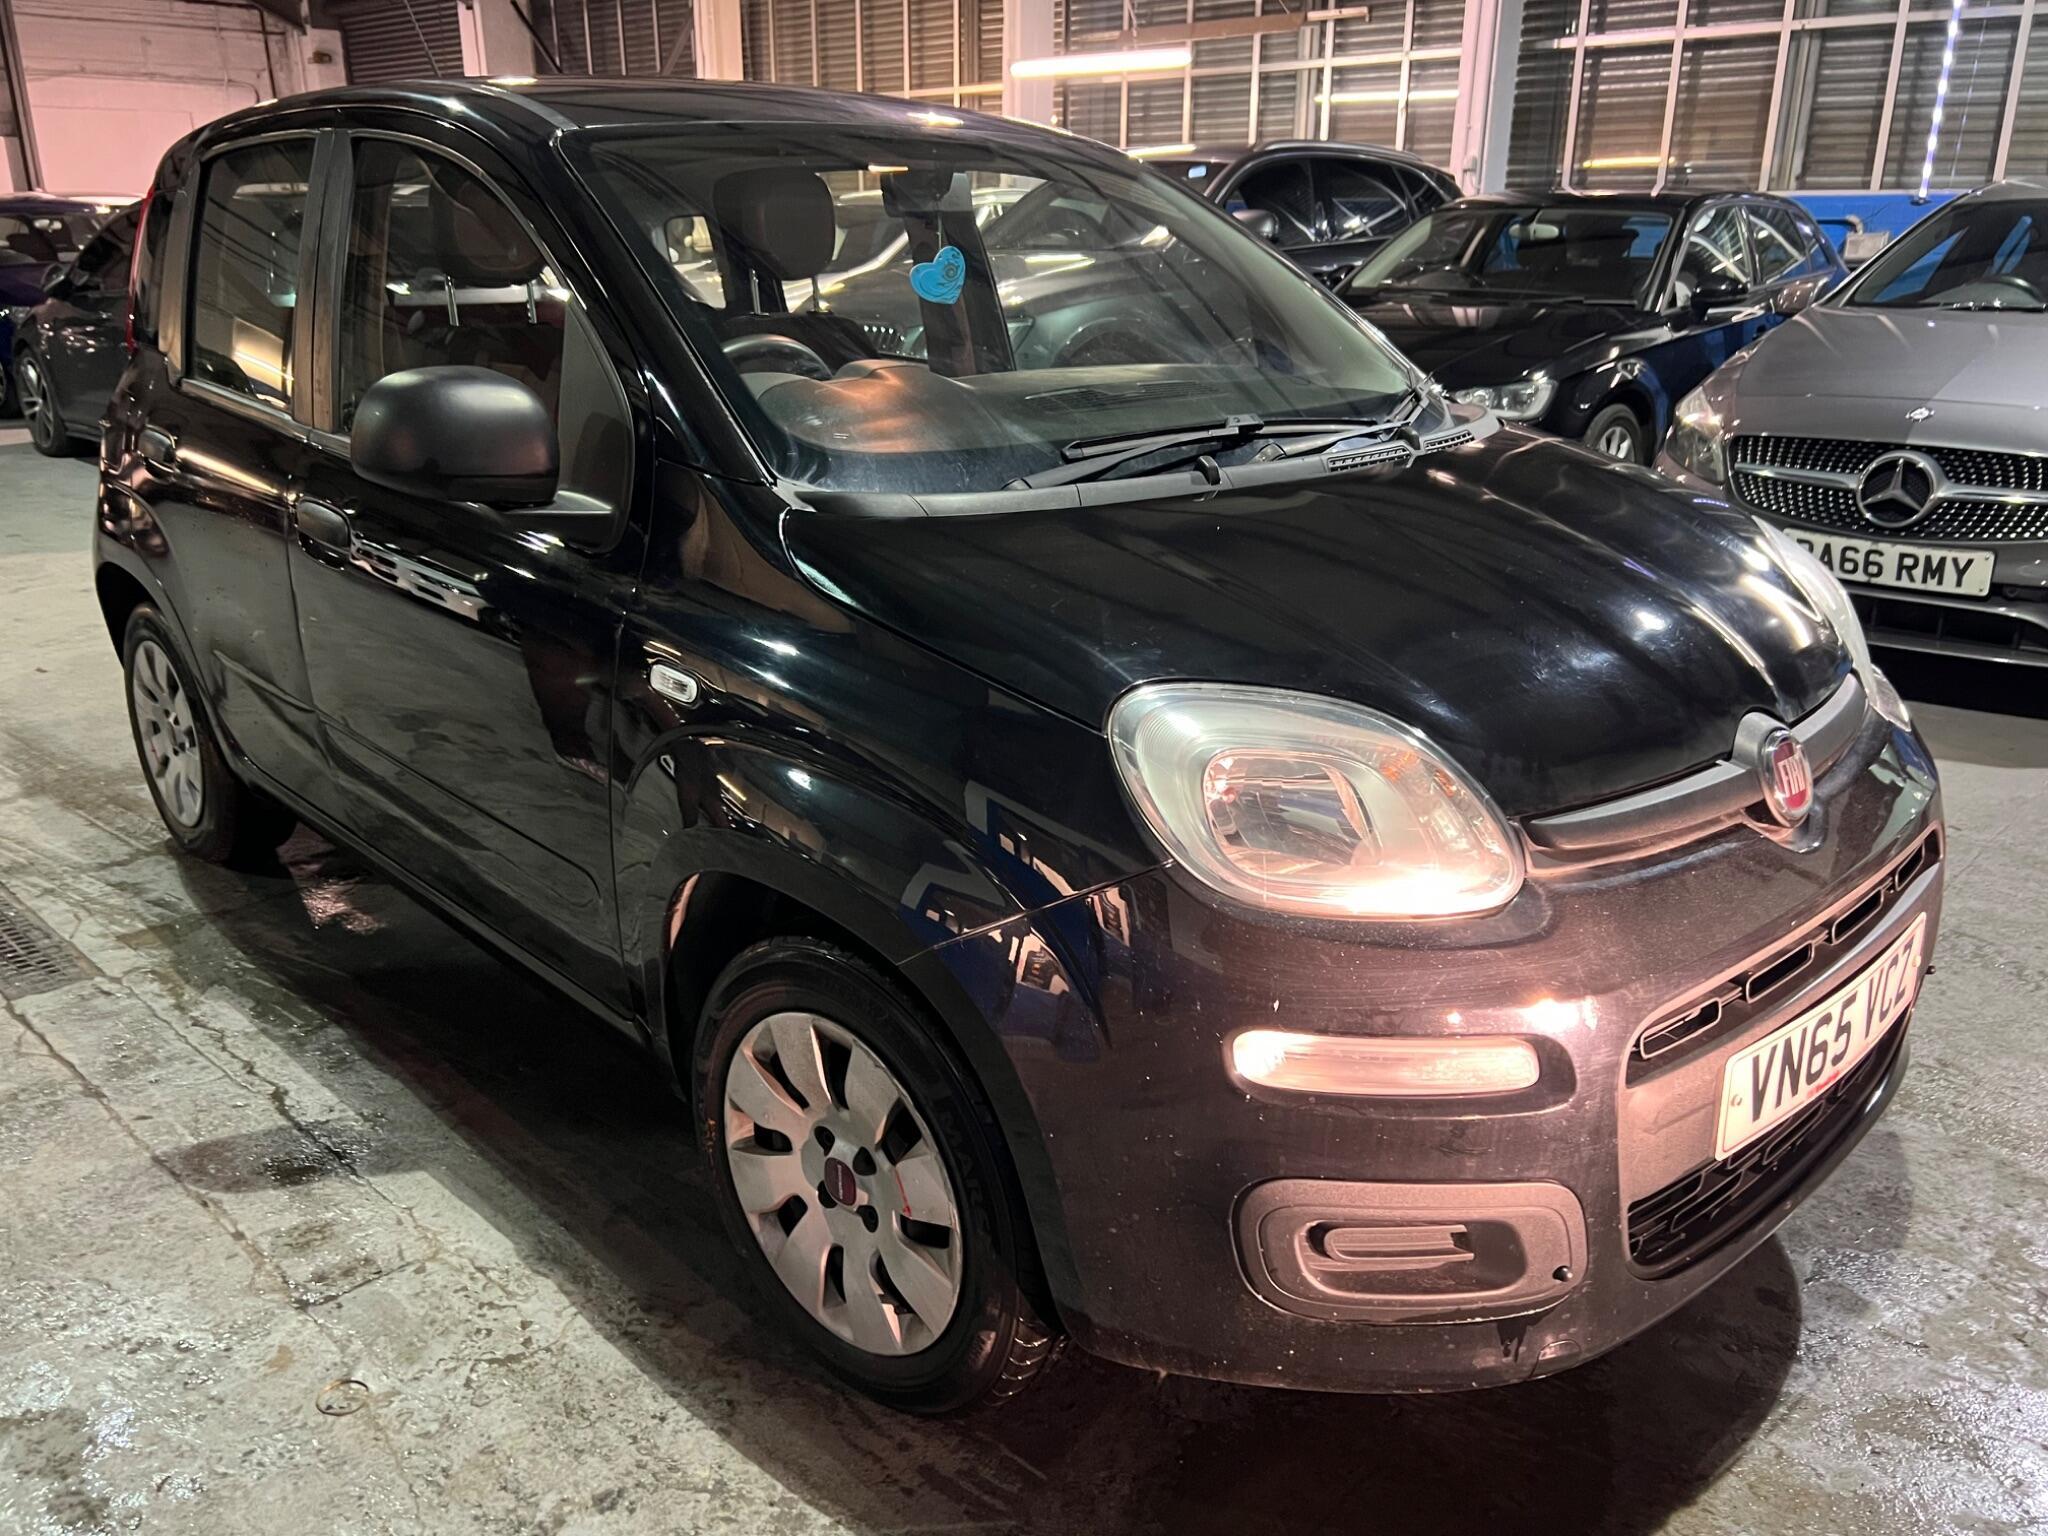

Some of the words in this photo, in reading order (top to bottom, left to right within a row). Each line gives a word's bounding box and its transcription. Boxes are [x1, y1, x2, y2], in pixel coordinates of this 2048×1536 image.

[1895, 552, 1975, 588] RMY
[1777, 751, 1807, 798] FIAT
[1751, 989, 1859, 1124] VN65
[1864, 934, 1915, 1041] VCZ
